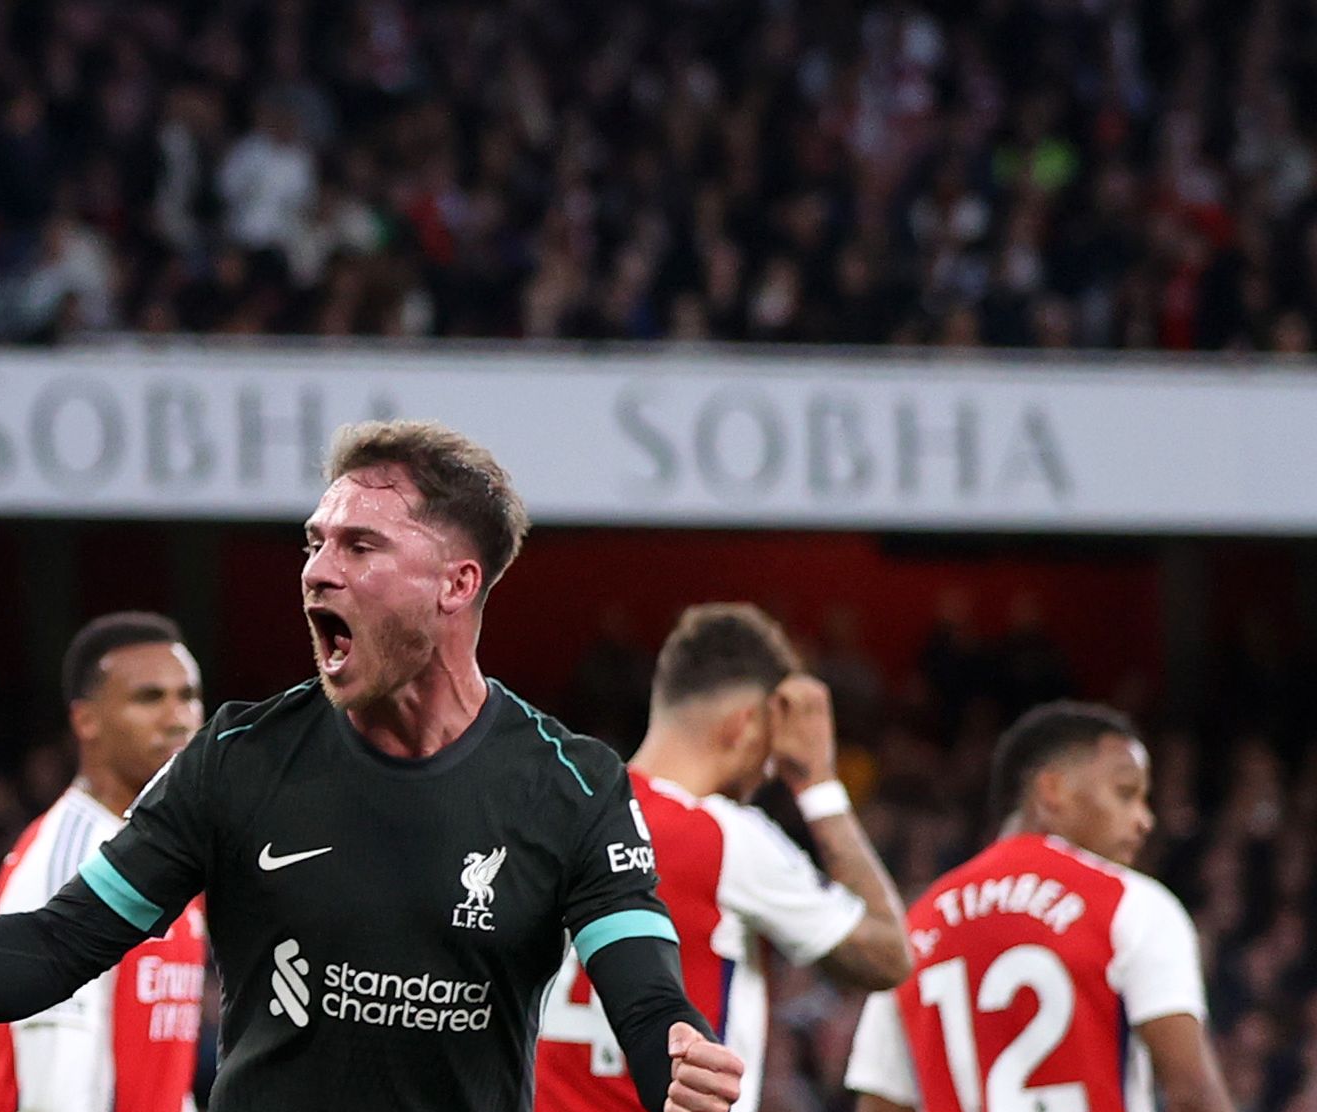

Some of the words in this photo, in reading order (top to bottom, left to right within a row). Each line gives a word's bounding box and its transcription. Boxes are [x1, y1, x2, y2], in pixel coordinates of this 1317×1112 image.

[613, 378, 1077, 504] SOBHA
[607, 842, 656, 875] Exp
[451, 908, 496, 931] L.F.C.
[934, 873, 1085, 934] TIMBER
[323, 962, 491, 1004] standard
[322, 991, 492, 1032] chartered
